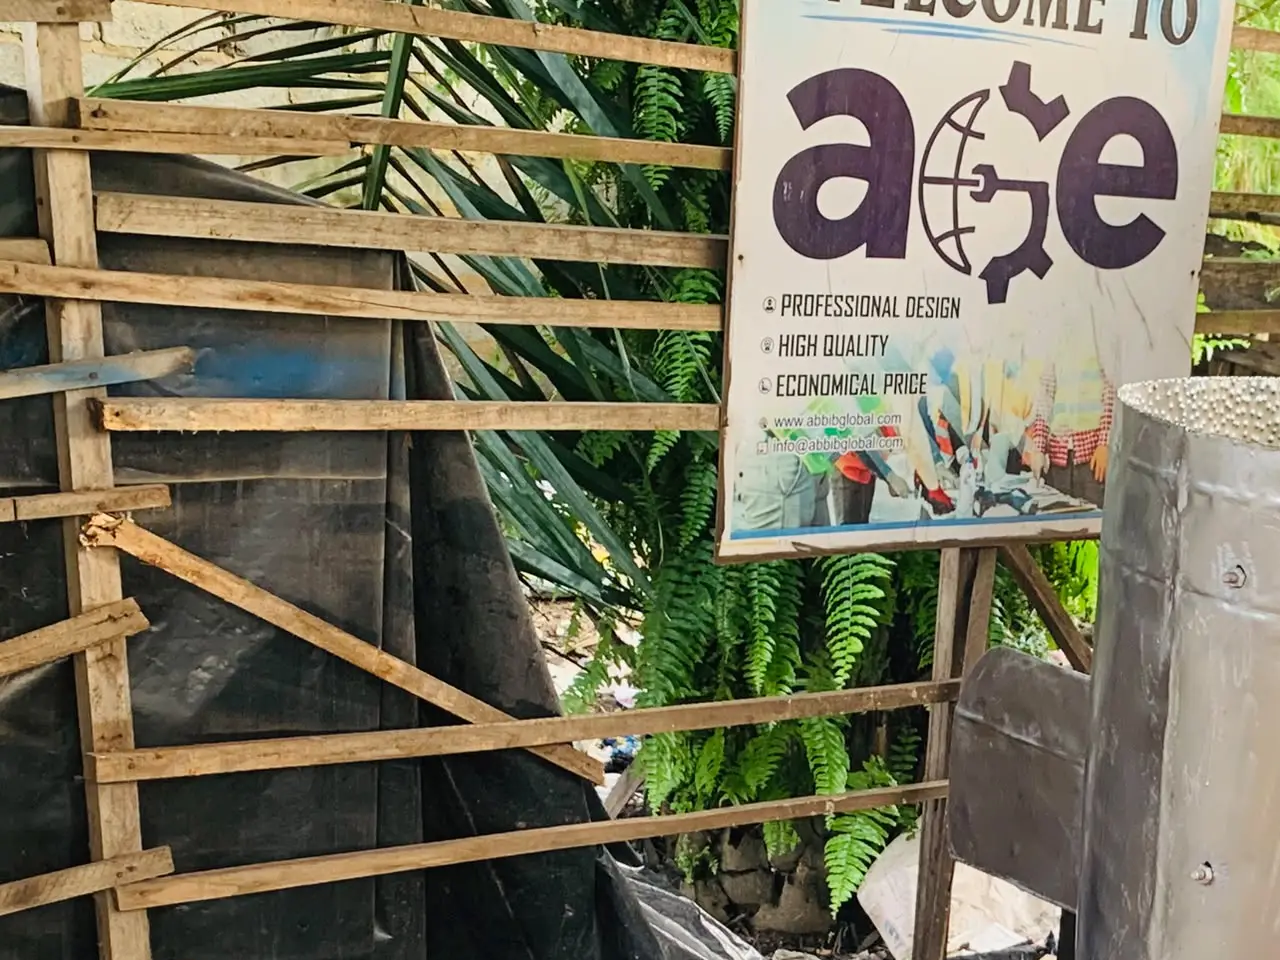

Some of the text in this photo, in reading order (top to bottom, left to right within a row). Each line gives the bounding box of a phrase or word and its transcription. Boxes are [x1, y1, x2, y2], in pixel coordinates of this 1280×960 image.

[780, 293, 961, 320] PROFESSIONAL DESIGN
[778, 333, 889, 358] HIGH QUALITY
[776, 373, 928, 398] ECONOMICAL PRICE
